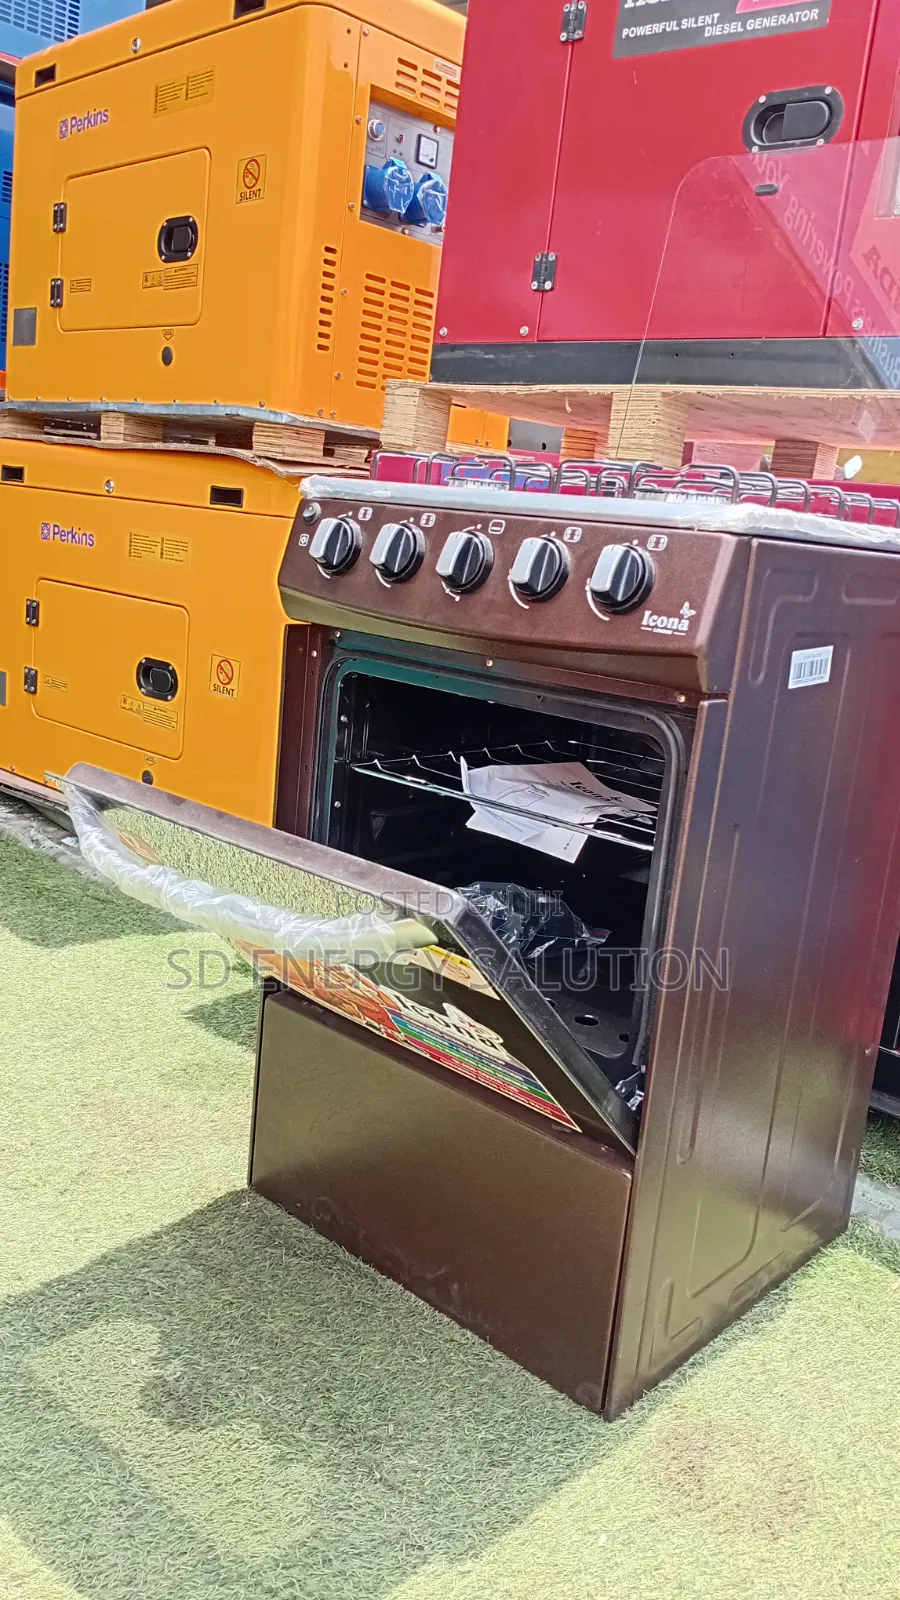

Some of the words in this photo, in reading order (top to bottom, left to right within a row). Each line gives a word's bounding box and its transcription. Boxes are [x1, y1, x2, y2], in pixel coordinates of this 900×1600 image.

[622, 20, 679, 38] POWERFUL
[681, 13, 720, 29] SILENT
[704, 22, 743, 37] DIESEL
[746, 9, 819, 30] GENERATOR
[70, 108, 109, 135] Perkins
[239, 188, 262, 201] SILENT
[53, 524, 95, 547] Perkins
[641, 610, 690, 631] Icona
[213, 683, 235, 697] SILENT
